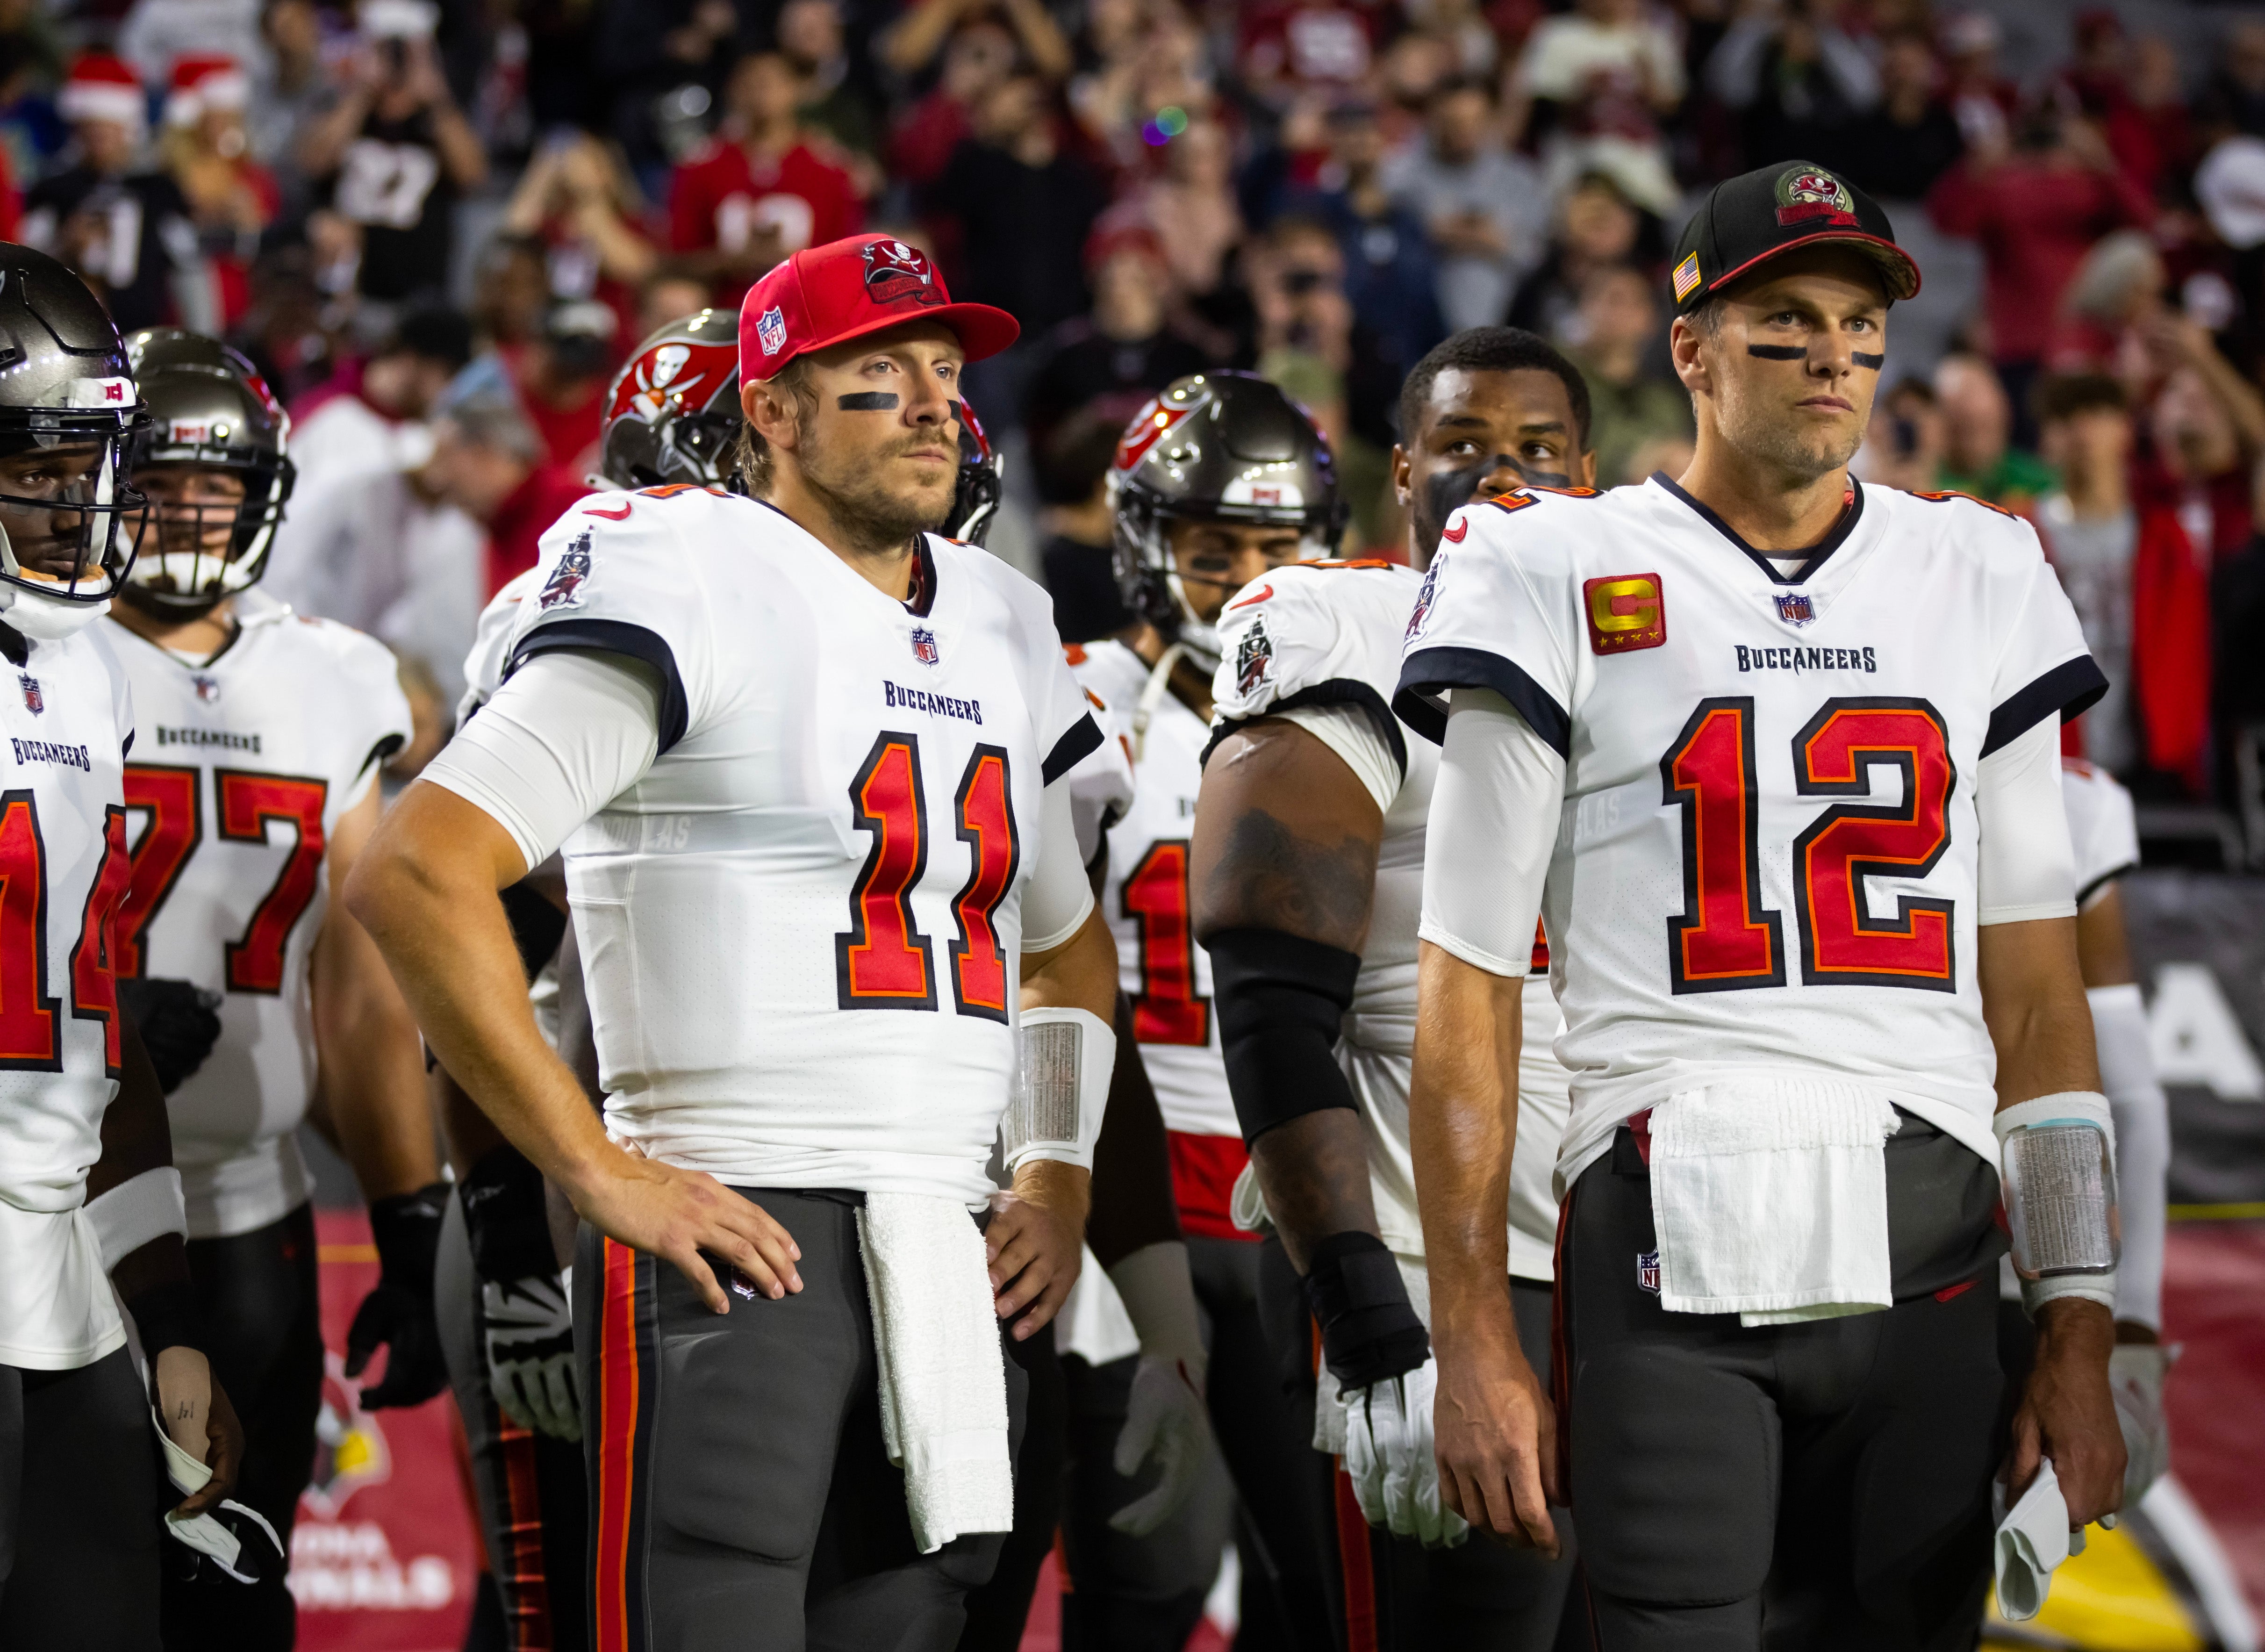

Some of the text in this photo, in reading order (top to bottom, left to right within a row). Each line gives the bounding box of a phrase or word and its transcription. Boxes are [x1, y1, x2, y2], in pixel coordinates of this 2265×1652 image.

[764, 326, 782, 350] NFL
[1591, 579, 1659, 632] C
[1783, 606, 1811, 620] NFL
[916, 643, 937, 661] NFL
[1734, 645, 1877, 676] BUCCANEERS
[882, 680, 982, 725] BUCCANEERS
[10, 738, 90, 772] BUCCANEERS
[157, 725, 261, 755] BUCCANEERS
[1659, 696, 1957, 996] 12
[115, 762, 329, 996] 77
[834, 730, 1020, 1026] 11
